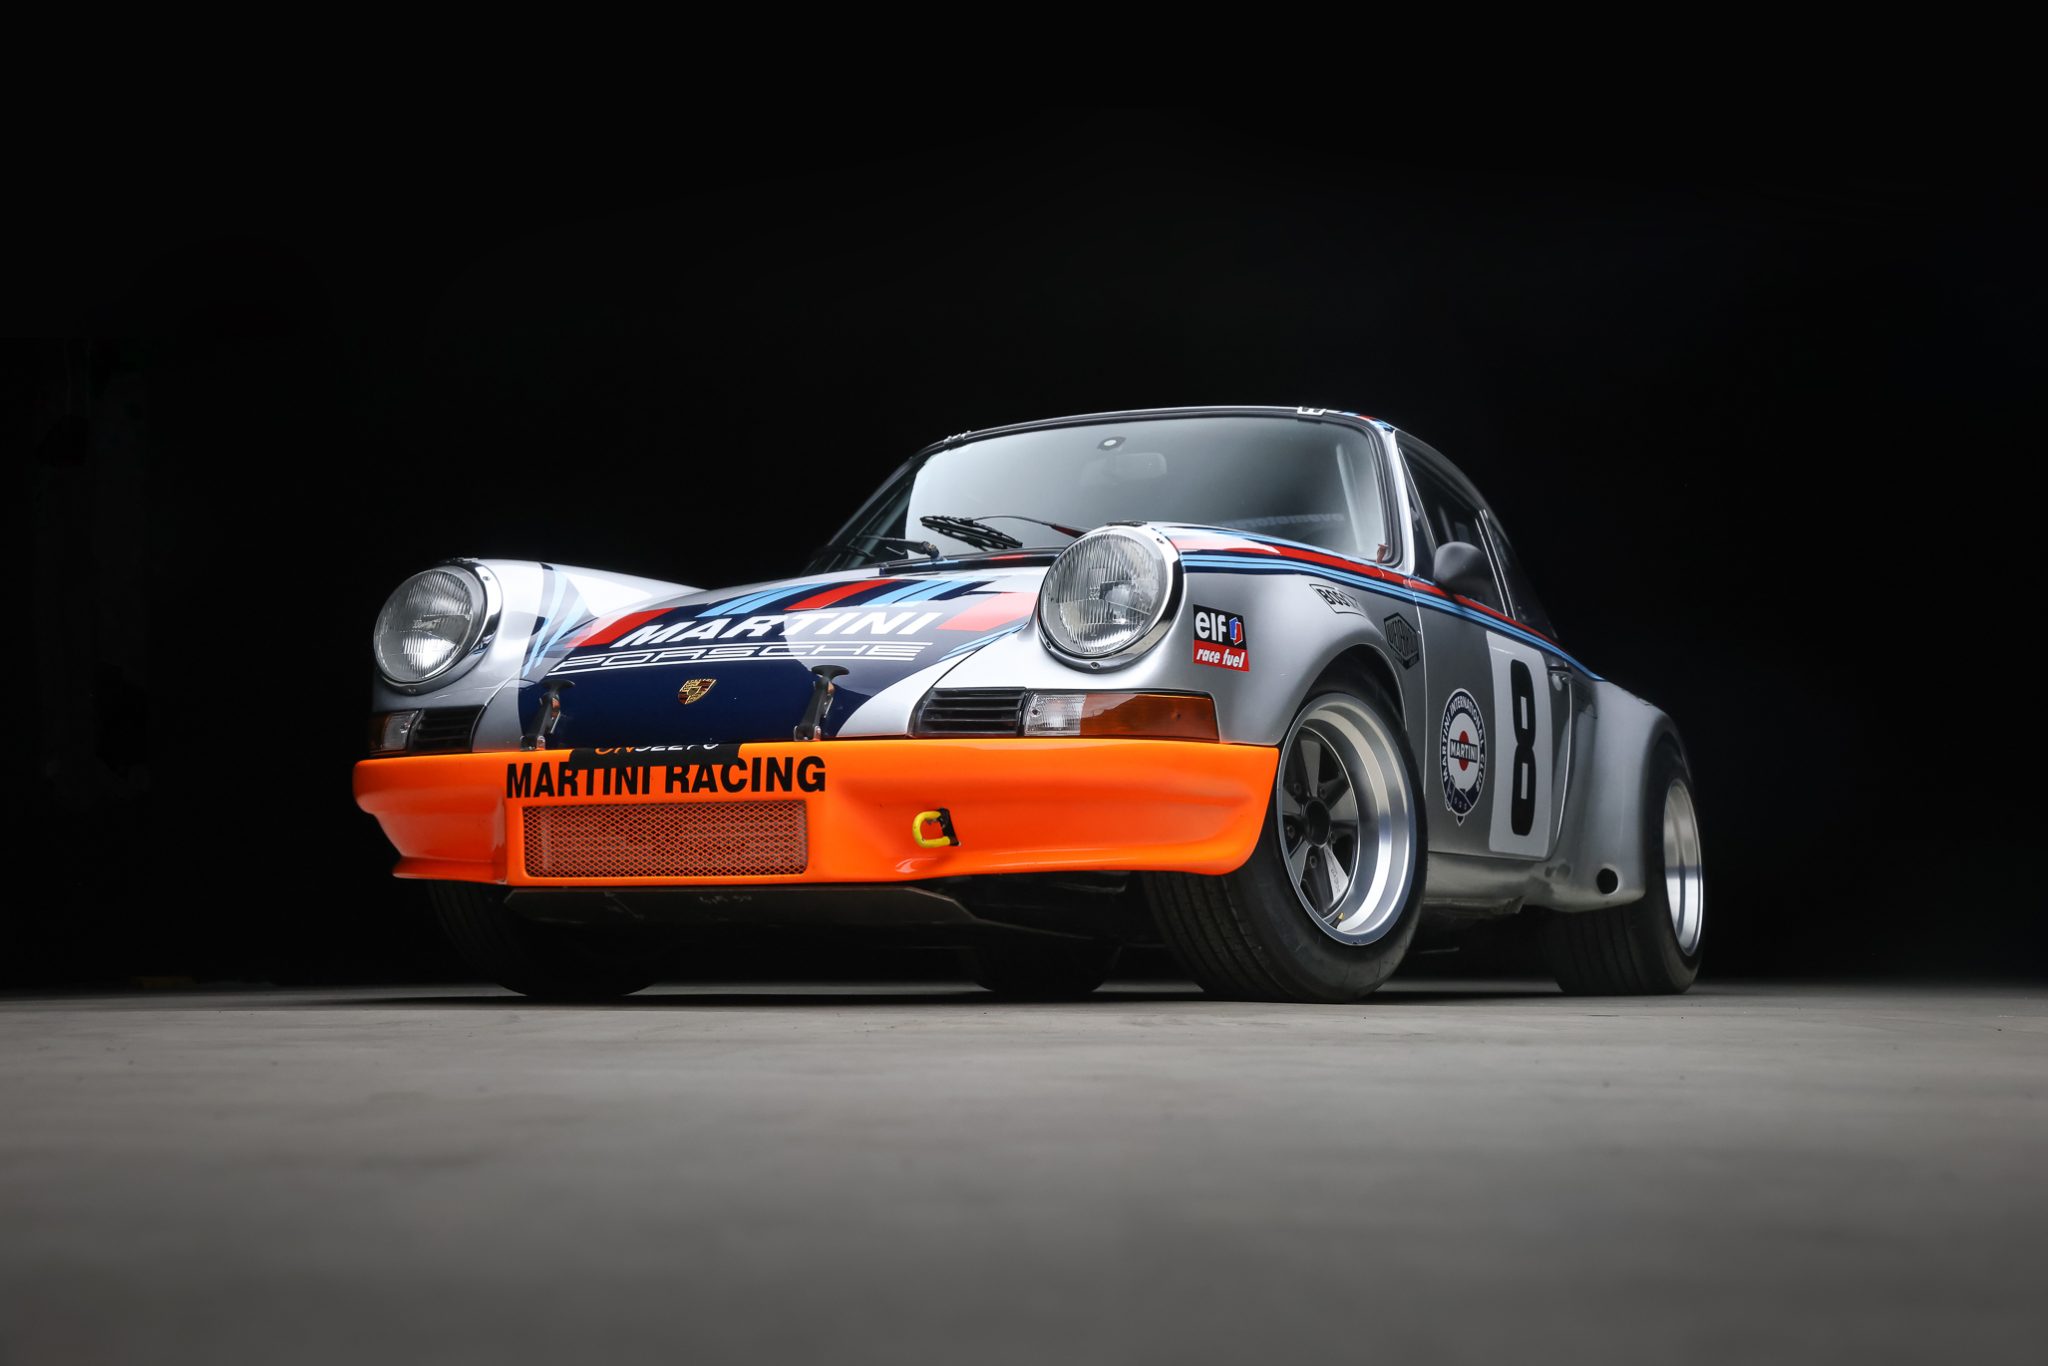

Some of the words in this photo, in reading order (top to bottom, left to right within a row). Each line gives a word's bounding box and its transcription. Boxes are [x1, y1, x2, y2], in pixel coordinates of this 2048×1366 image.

[610, 611, 943, 648] MARTINI
[1195, 611, 1227, 642] elf
[553, 643, 927, 672] PORSCHE
[1196, 648, 1220, 664] race
[1222, 648, 1246, 668] fuel
[1442, 710, 1451, 782] MARTINI
[1448, 695, 1484, 745] INTERNATIONAL
[1450, 741, 1477, 761] MARTINI
[1510, 659, 1536, 836] 8
[506, 761, 651, 799] MARTINI
[664, 756, 826, 793] RACING
